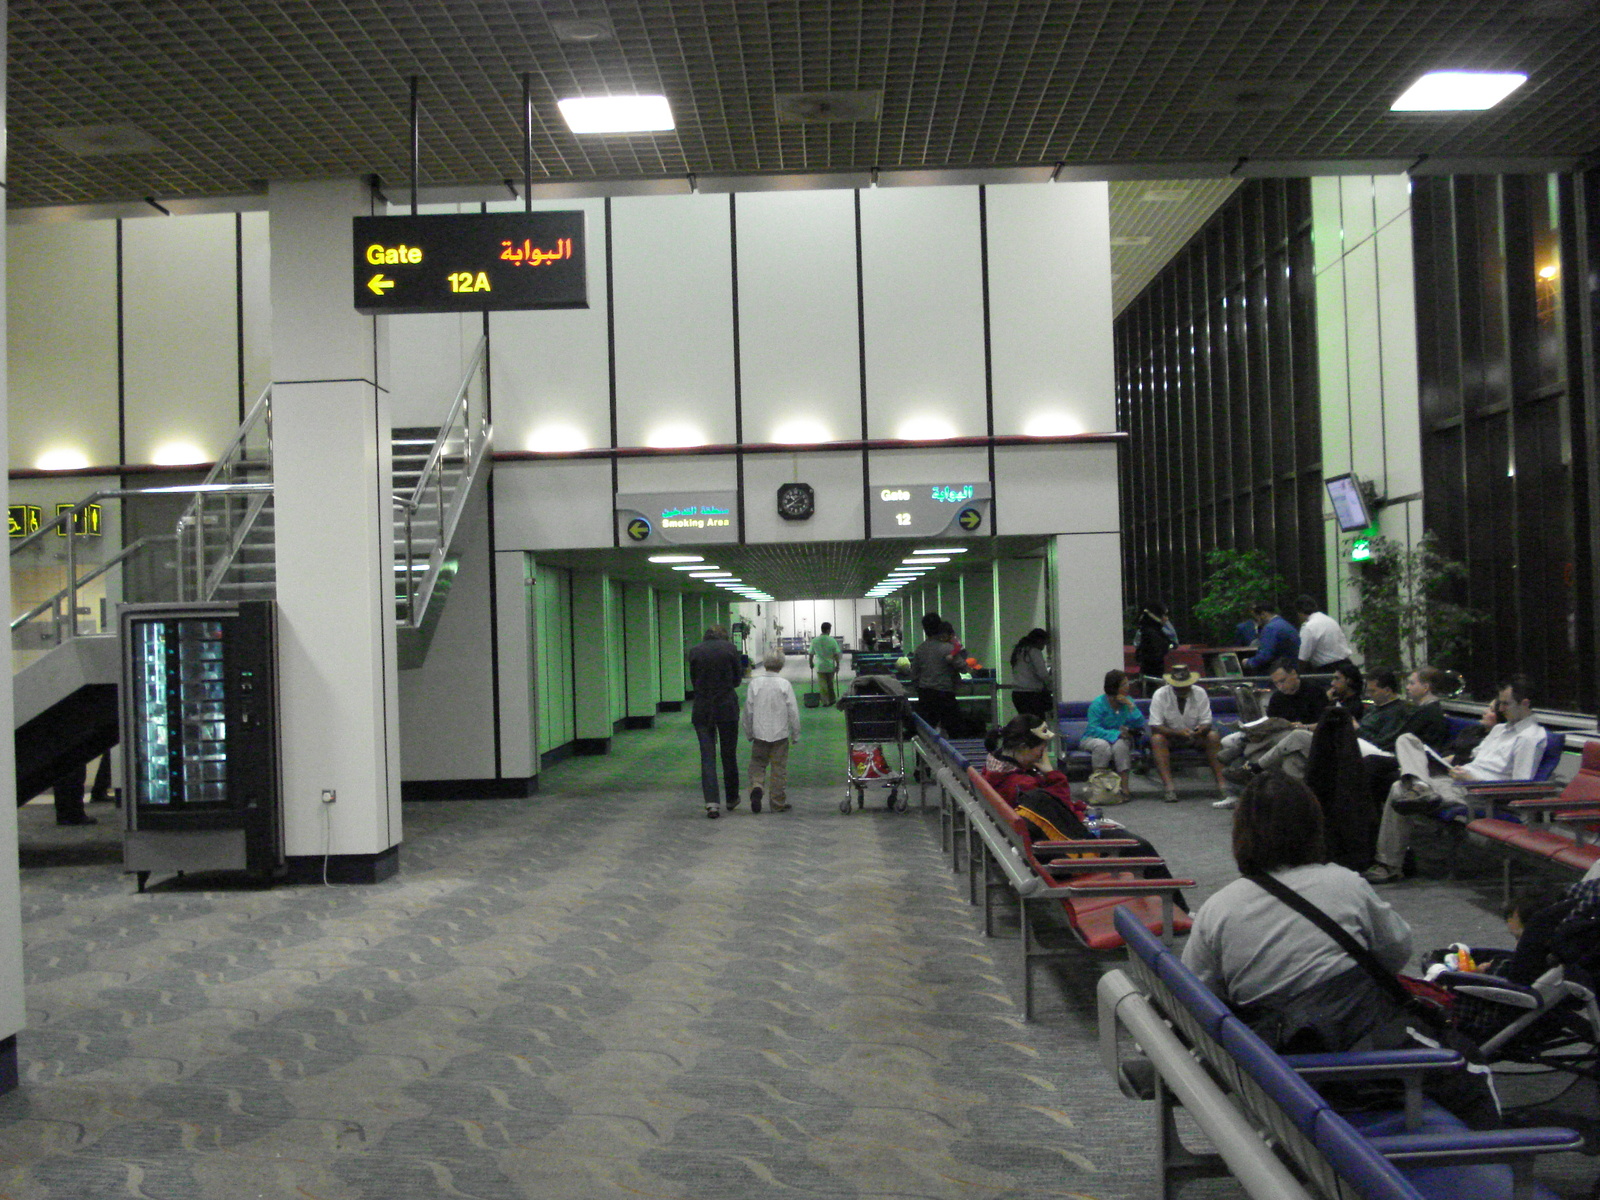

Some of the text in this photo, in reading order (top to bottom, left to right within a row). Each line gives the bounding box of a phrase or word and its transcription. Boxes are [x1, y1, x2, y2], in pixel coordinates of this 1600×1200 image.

[366, 244, 423, 265] Gate
[500, 238, 572, 267] البوابة
[447, 271, 491, 293] 12A
[881, 489, 911, 501] Gate
[931, 485, 974, 502] البوابة
[662, 517, 730, 529] Smoking Area
[895, 512, 912, 526] 12
